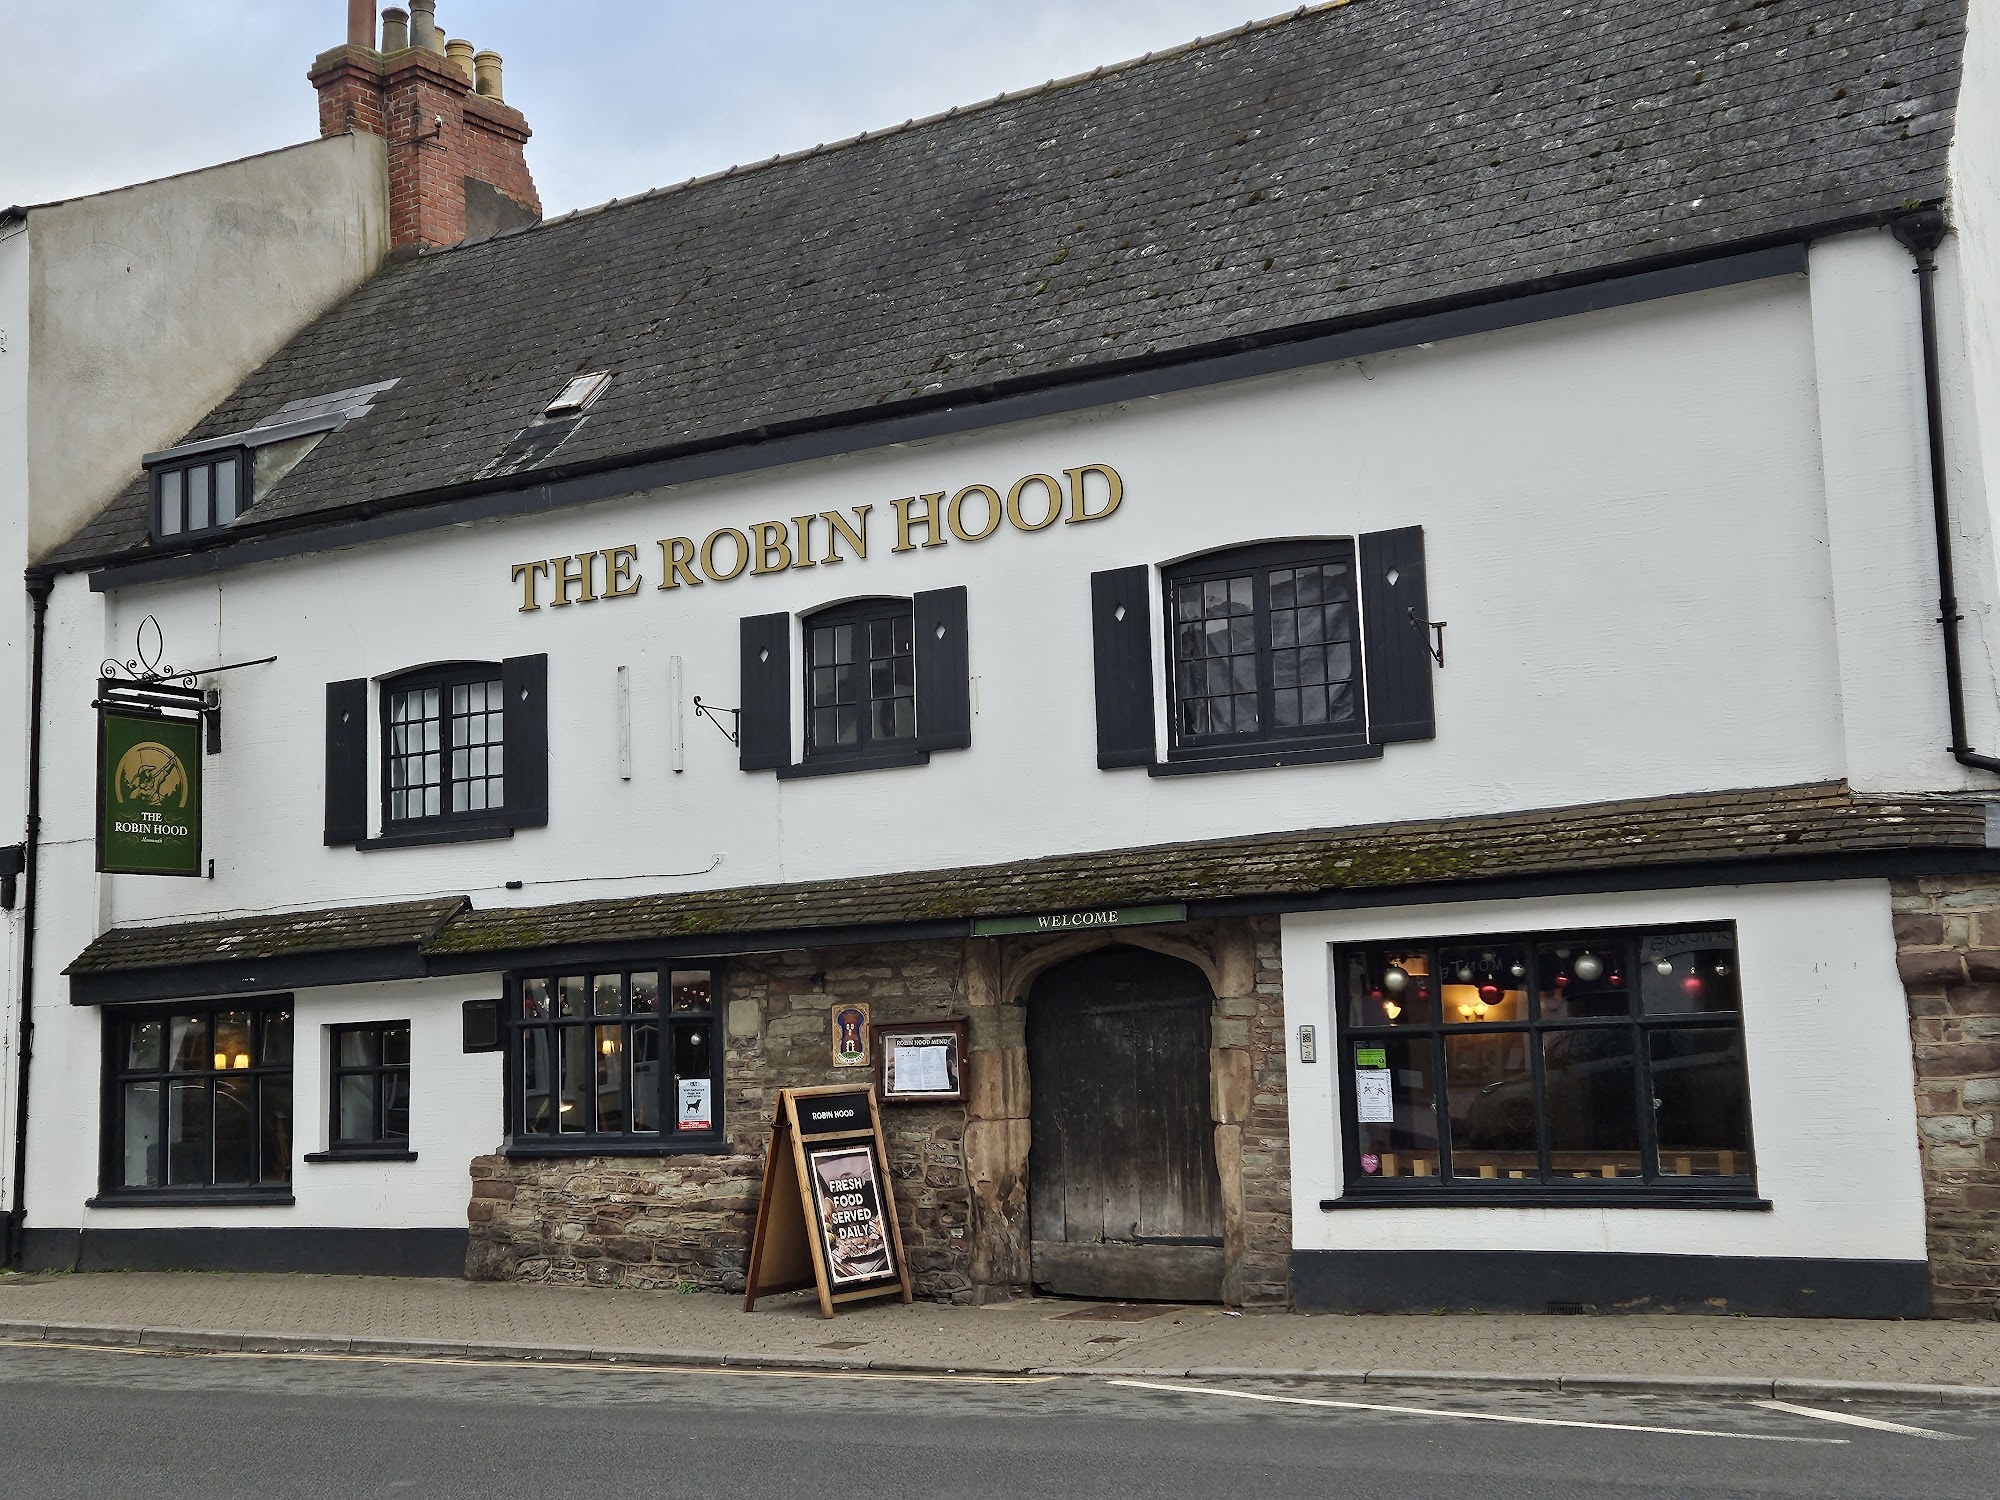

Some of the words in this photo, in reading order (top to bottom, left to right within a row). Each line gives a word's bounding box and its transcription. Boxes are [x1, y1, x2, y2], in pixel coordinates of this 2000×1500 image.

[511, 544, 643, 613] THE
[657, 504, 875, 592] ROBIN
[889, 462, 1124, 554] HOOD
[141, 811, 163, 822] THE
[114, 821, 151, 834] ROBIN
[153, 824, 188, 836] HOOD
[1037, 910, 1119, 928] WELCOME
[931, 1038, 948, 1046] MENU
[812, 1111, 834, 1121] ROBIN
[834, 1109, 855, 1119] HOOD
[829, 1176, 863, 1193] FRESH
[832, 1193, 864, 1208] FOOD
[831, 1208, 872, 1225] SERVED
[838, 1223, 870, 1240] DAILY
